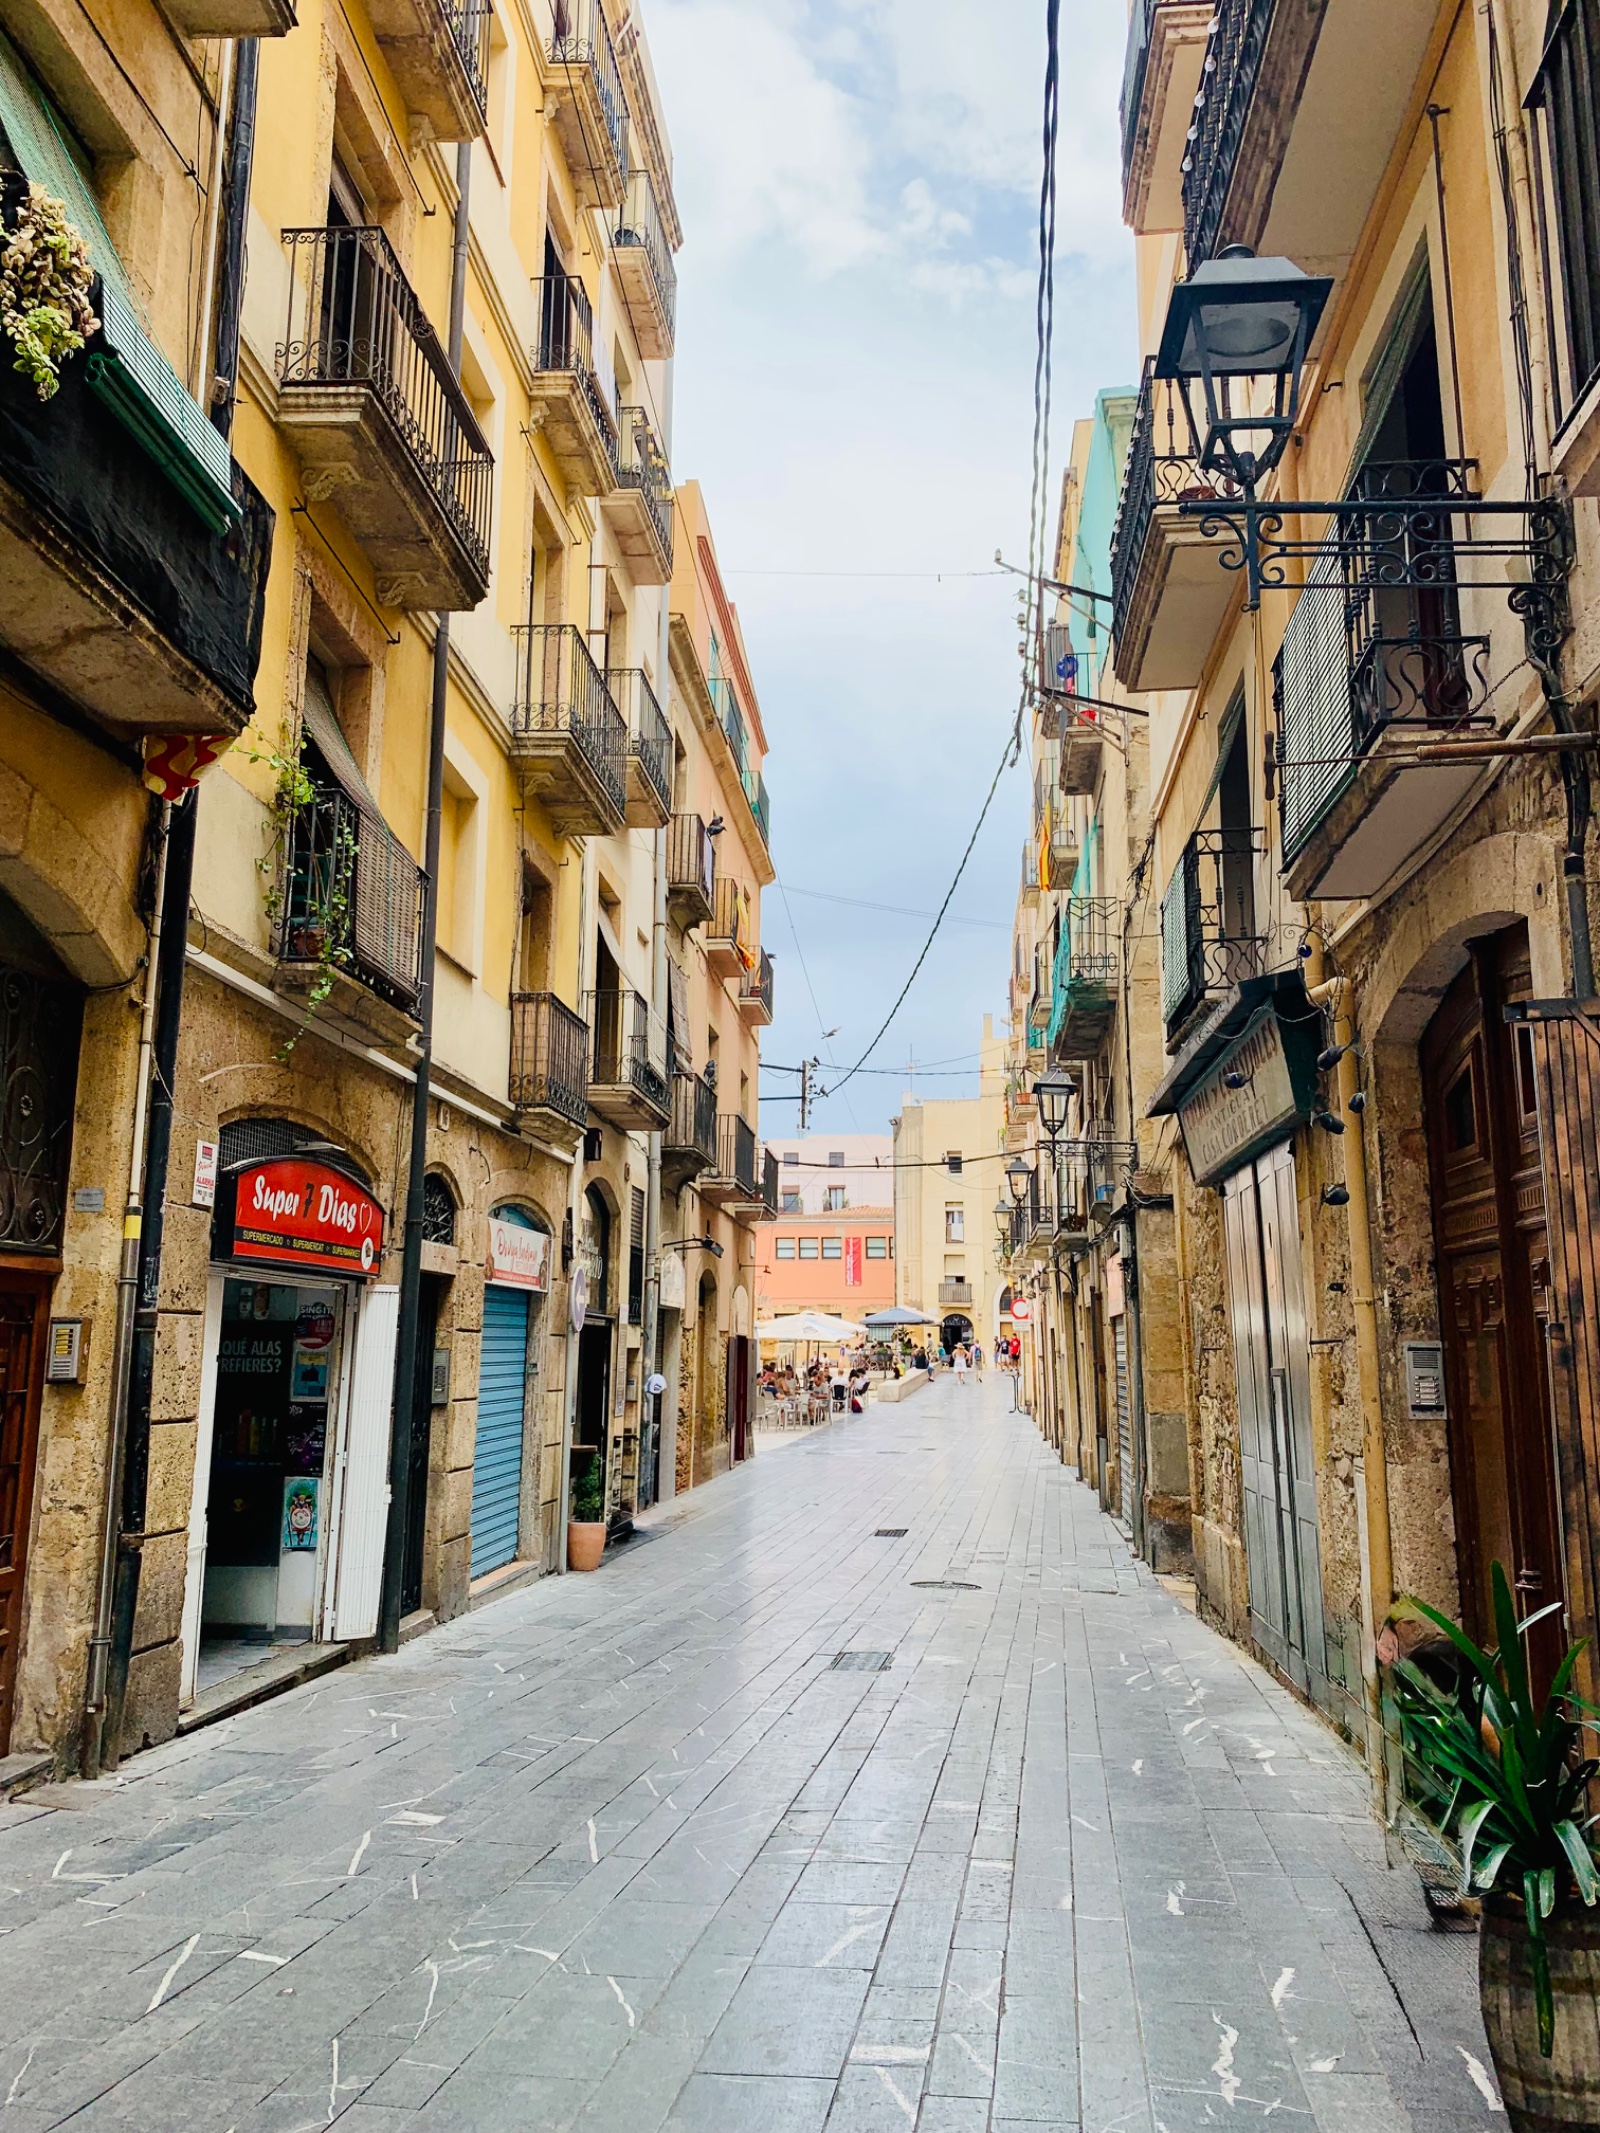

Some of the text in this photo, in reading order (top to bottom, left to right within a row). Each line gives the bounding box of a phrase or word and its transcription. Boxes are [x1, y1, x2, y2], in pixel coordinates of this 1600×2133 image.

[1209, 1091, 1252, 1132] ANTIGUA
[1202, 1137, 1223, 1165] CASA
[252, 1175, 358, 1233] Super 7 Dias
[242, 1229, 284, 1246] SUPERMERCADO
[292, 1239, 325, 1253] SUPERMERCAT
[250, 1340, 282, 1356] ALAS
[218, 1357, 282, 1373] REFIERES?
